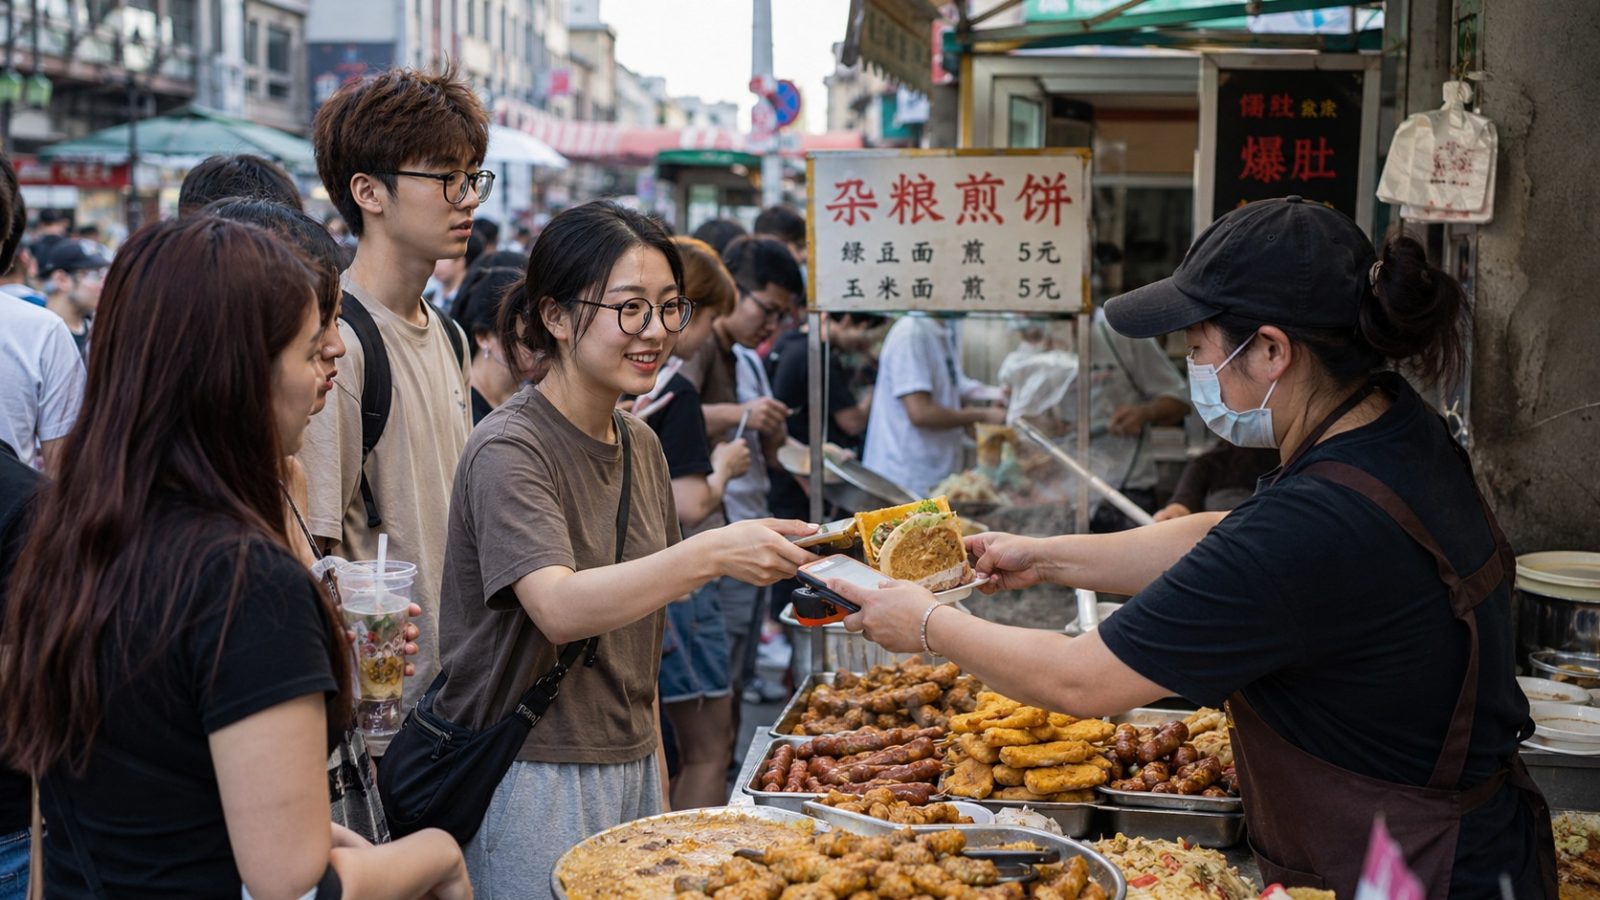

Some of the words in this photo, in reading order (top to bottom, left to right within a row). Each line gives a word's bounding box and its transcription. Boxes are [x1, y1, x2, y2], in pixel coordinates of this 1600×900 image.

[1238, 134, 1337, 184] 爆肚
[826, 171, 1073, 227] 杂粮煎饼
[841, 241, 934, 264] 绿豆面
[961, 238, 985, 265] 煎
[1017, 240, 1062, 265] 5元
[841, 275, 934, 300] 玉米面
[961, 275, 985, 300] 煎
[1017, 276, 1062, 300] 5元
